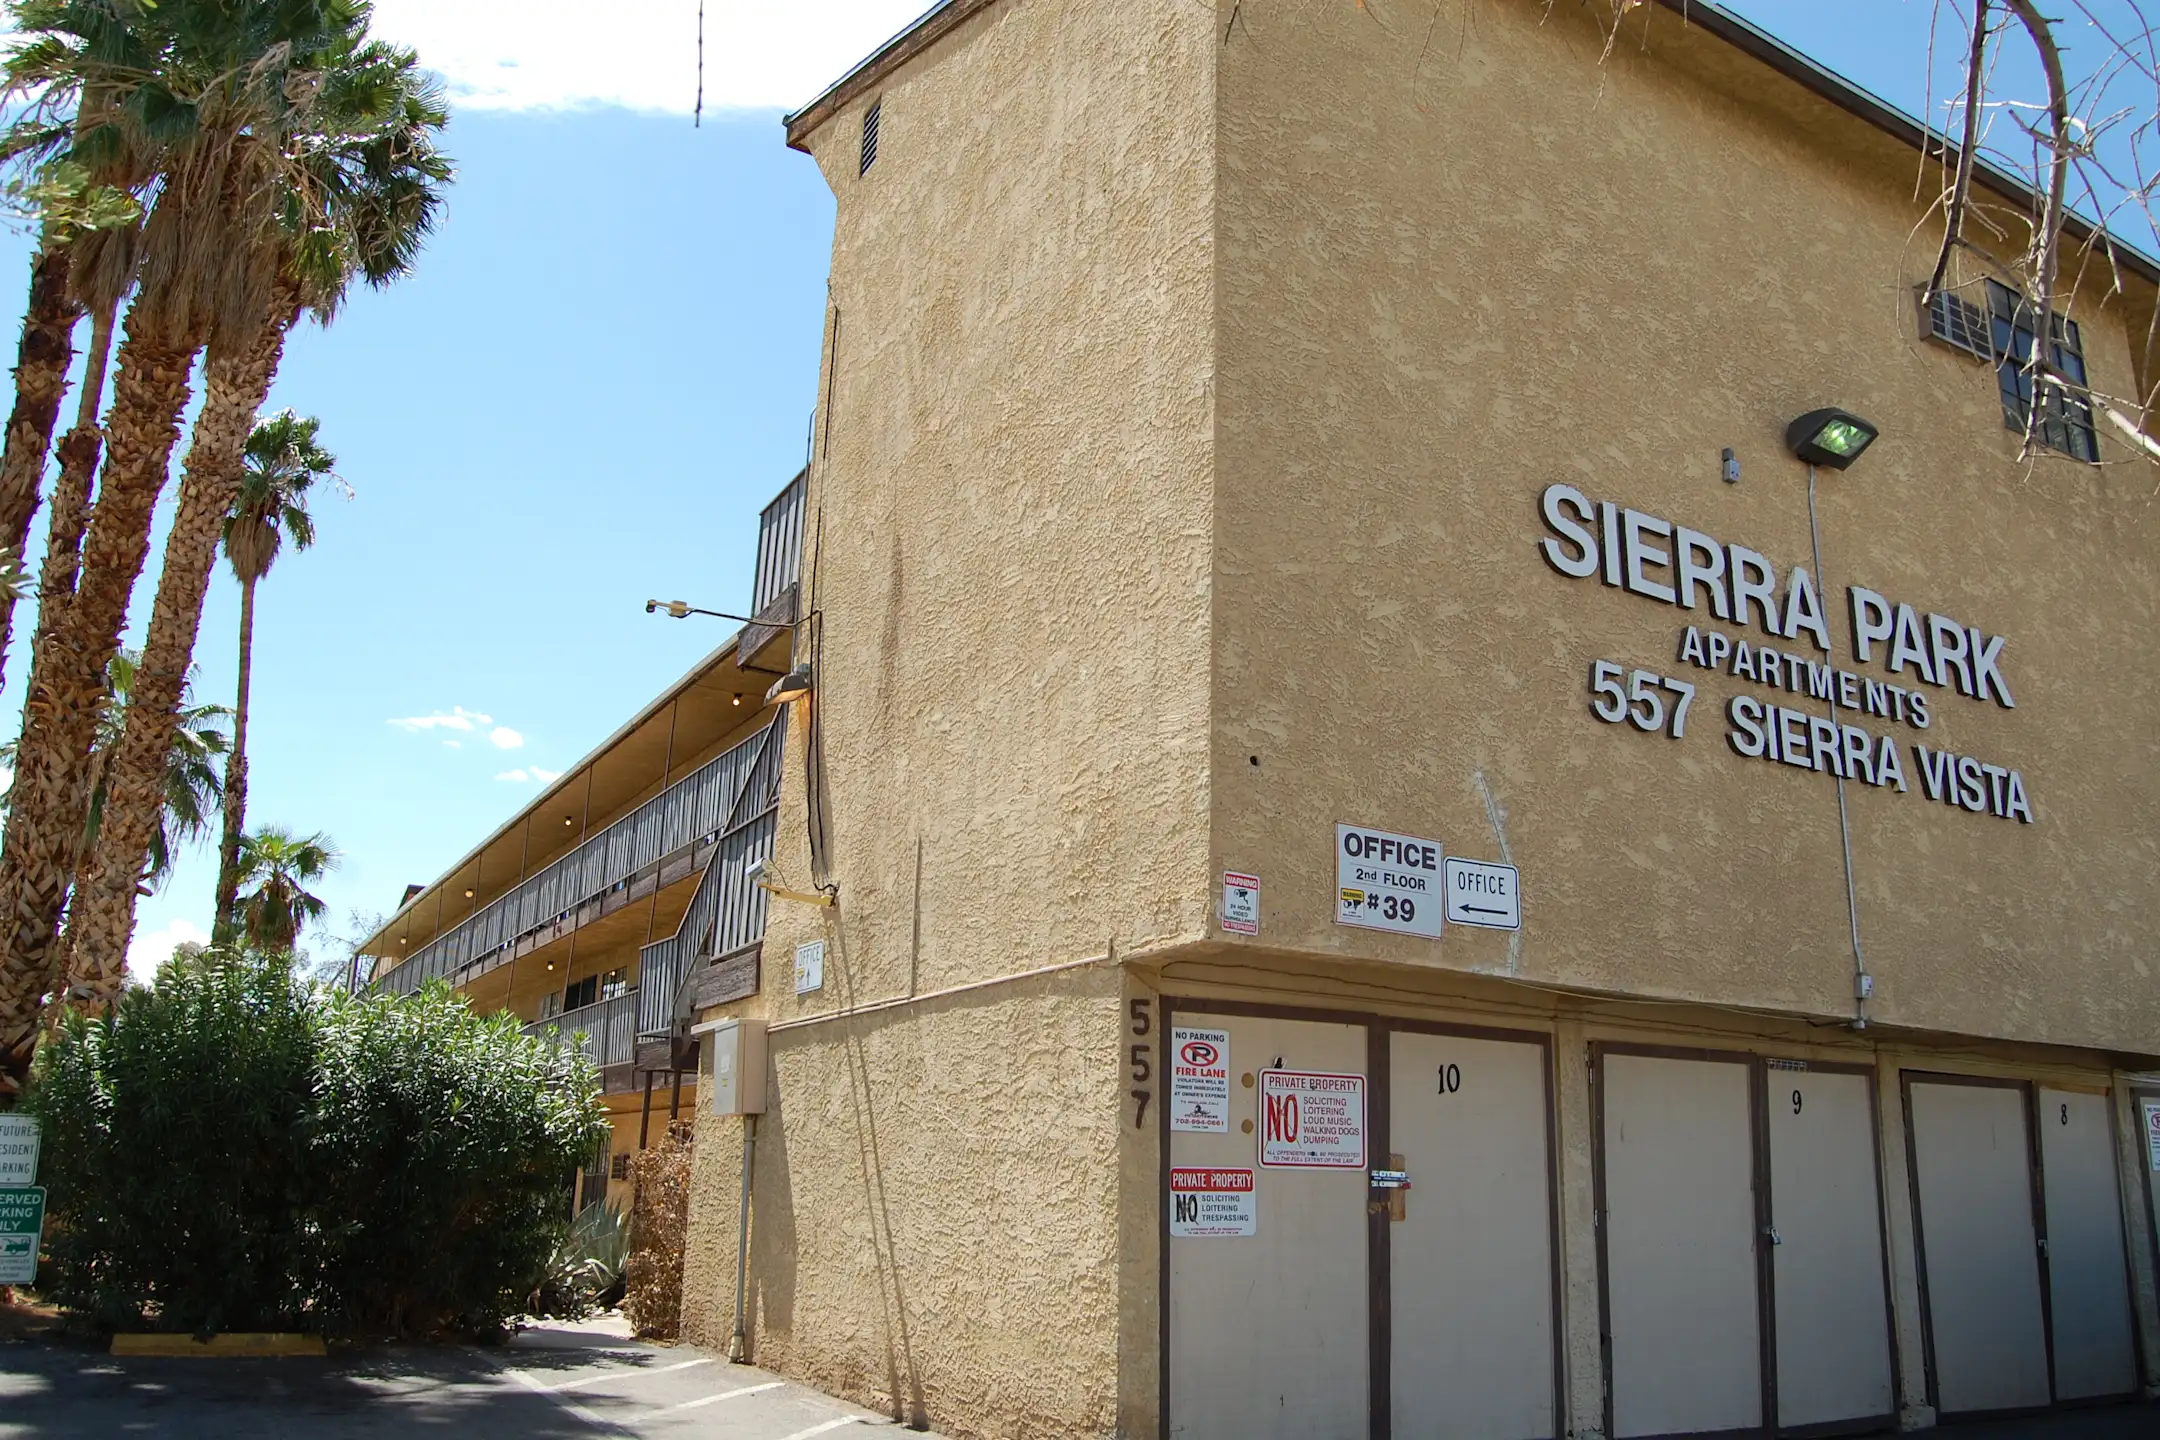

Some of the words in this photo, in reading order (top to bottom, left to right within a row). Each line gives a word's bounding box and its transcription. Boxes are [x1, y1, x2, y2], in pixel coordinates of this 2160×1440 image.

[1540, 484, 1831, 649] SIERRA
[1848, 585, 2016, 708] PARK
[1679, 626, 1930, 728] APARTMENTS
[1591, 660, 1694, 738] 557
[1727, 695, 1906, 792] SIERRA
[1913, 745, 2034, 823] VISTA
[1344, 832, 1437, 871] OFFICE
[1226, 876, 1257, 888] WARNING
[1356, 868, 1377, 881] 2nd
[1383, 873, 1426, 891] FLOOR
[1458, 871, 1506, 895] OFFICE
[1367, 892, 1415, 922] #39
[1175, 1031, 1188, 1040] NO
[1189, 1032, 1225, 1043] PARKING
[1175, 1066, 1197, 1077] FIRE
[1200, 1068, 1226, 1078] LANE
[1438, 1064, 1461, 1095] 10
[1269, 1076, 1306, 1089] PRIVATE
[1309, 1078, 1358, 1092] PROPERTY
[1303, 1097, 1347, 1106] SOLICITING
[1792, 1089, 1802, 1115] 9
[1267, 1094, 1298, 1143] NO
[1303, 1106, 1345, 1116] LOITERING
[2060, 1103, 2068, 1126] 8
[1303, 1116, 1325, 1125] LOUD
[1327, 1117, 1352, 1126] MUSIC
[1303, 1126, 1337, 1135] WALKING
[1338, 1127, 1360, 1136] DOGS
[1303, 1136, 1340, 1145] DUMPING
[0, 1162, 30, 1174] RKING
[1172, 1172, 1207, 1188] PRIVATE
[1211, 1173, 1252, 1188] PROPERTY
[1201, 1194, 1240, 1202] SOLICITING
[0, 1207, 33, 1218] KING
[1176, 1194, 1198, 1223] NO
[1201, 1204, 1238, 1212] LOITERING
[1201, 1214, 1249, 1222] TRESPASSING
